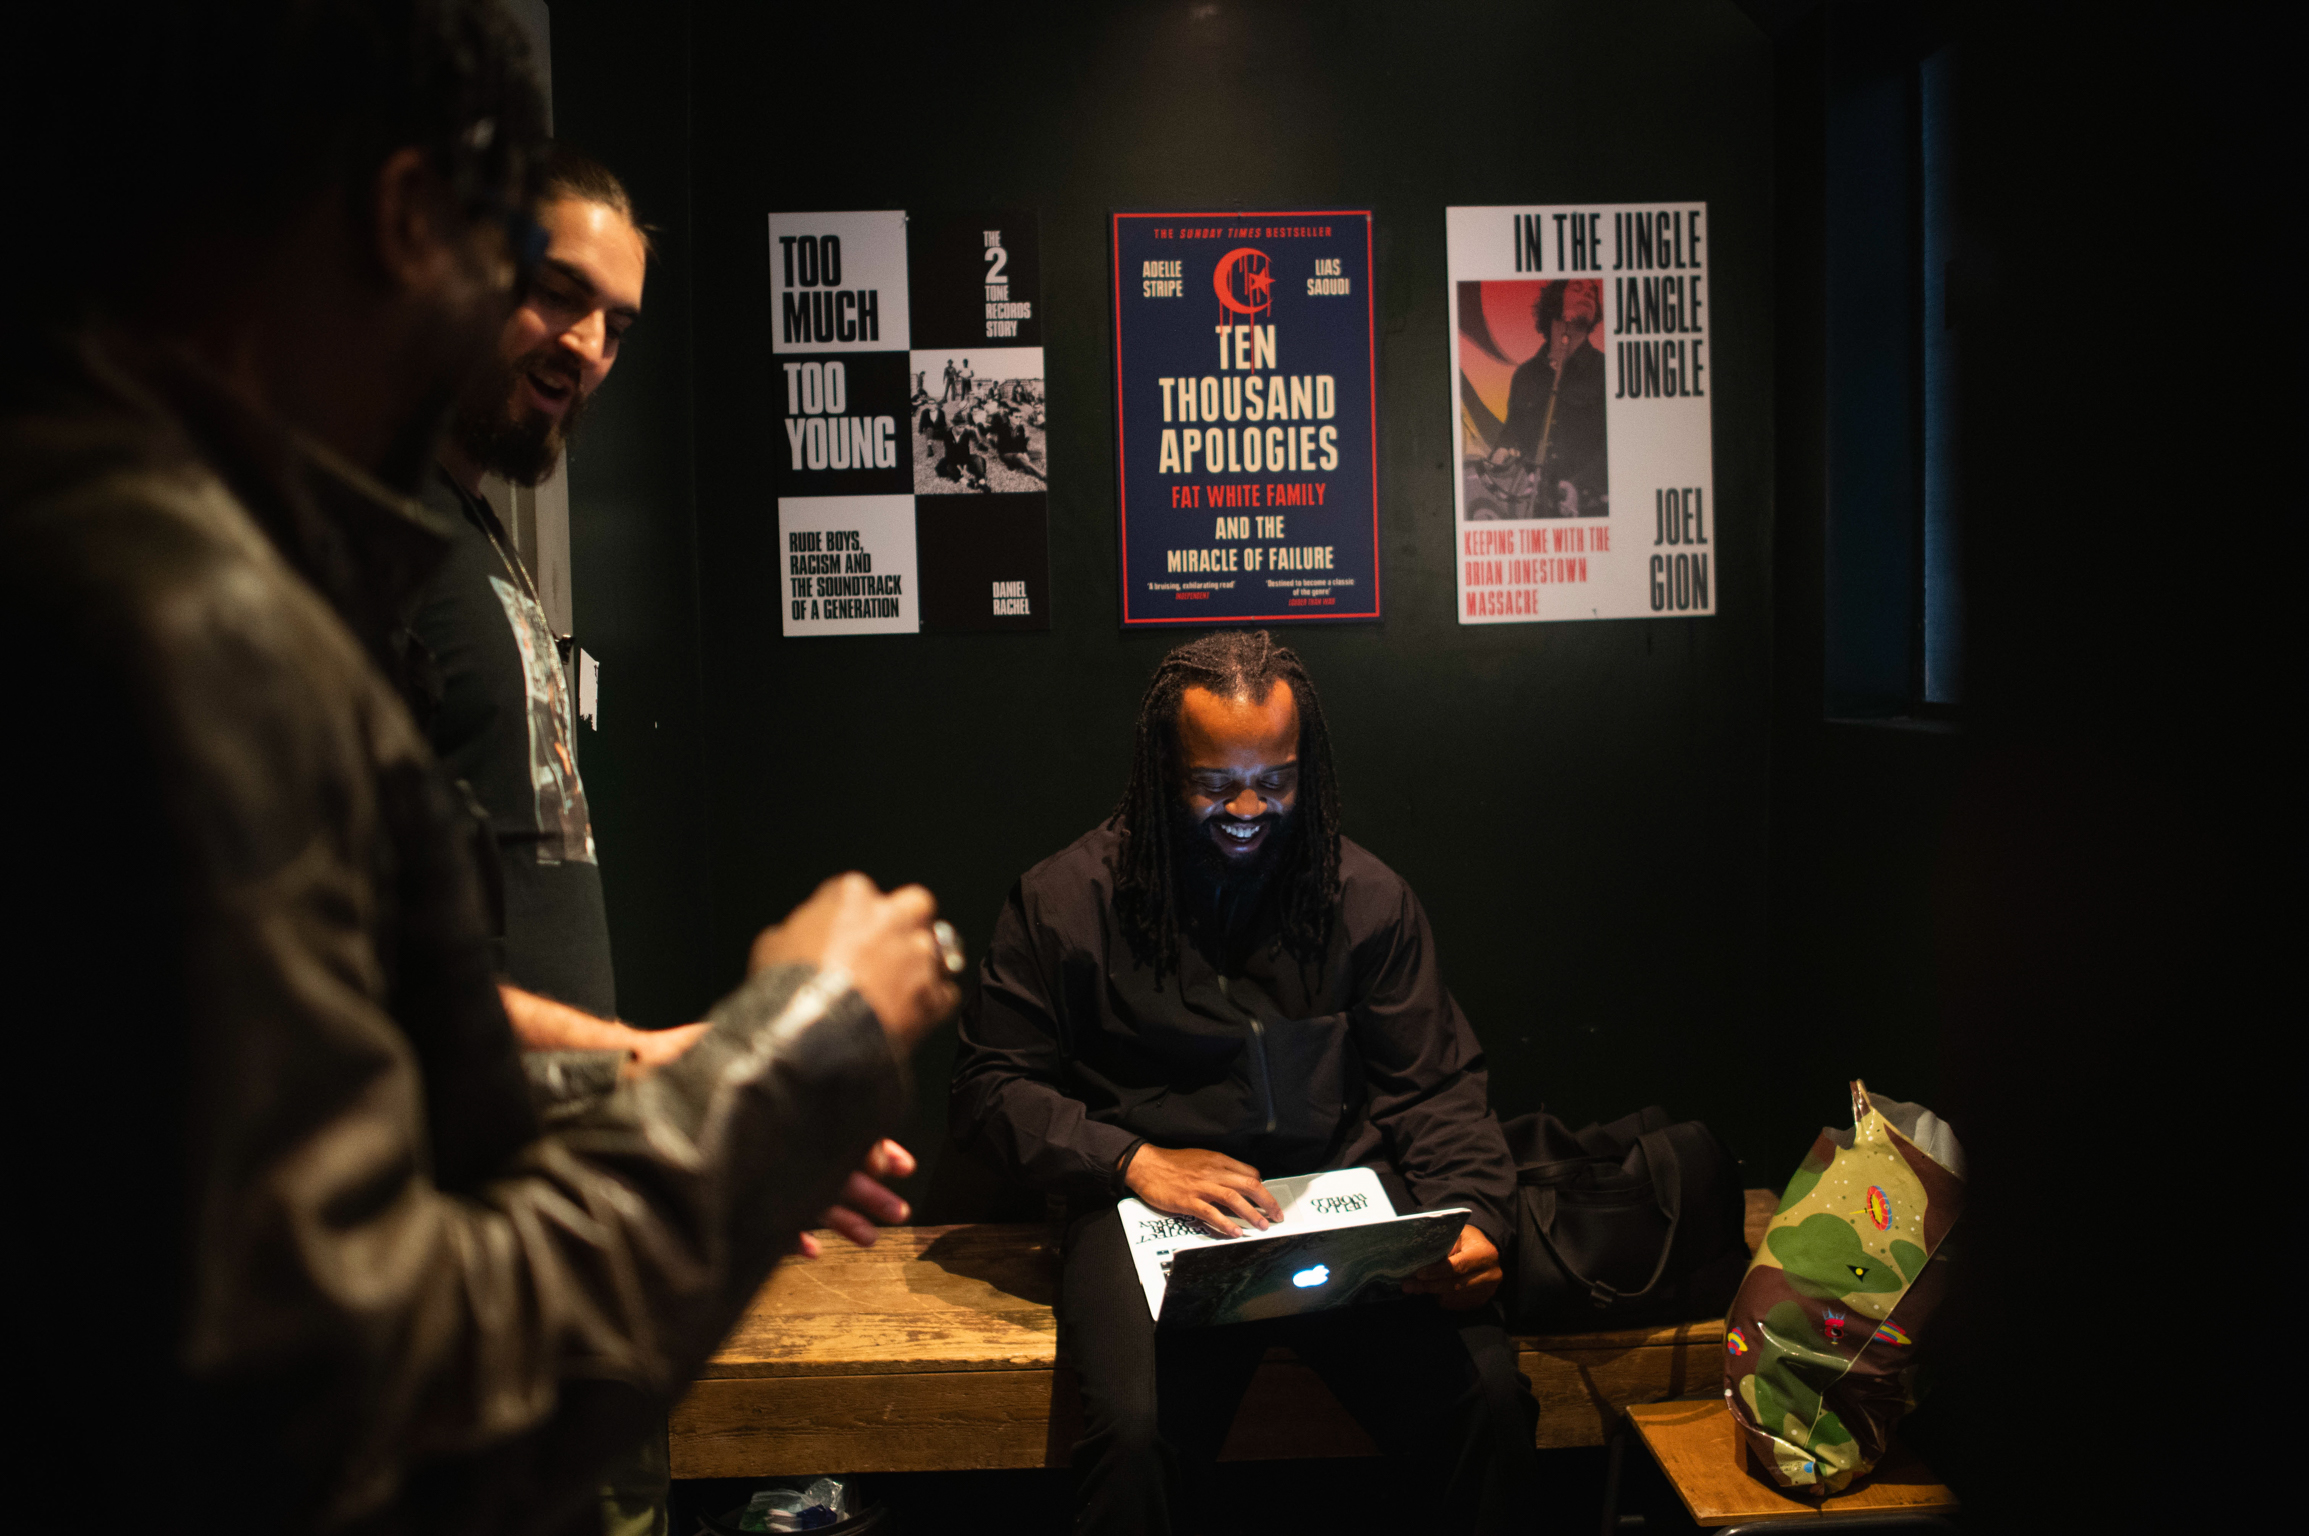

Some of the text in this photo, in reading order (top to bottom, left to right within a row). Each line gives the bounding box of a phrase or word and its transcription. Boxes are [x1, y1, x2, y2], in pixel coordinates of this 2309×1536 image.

[983, 230, 1000, 248] THE
[1154, 226, 1332, 239] THE SUNDAY TIMES BESTSELLER
[1514, 210, 1702, 272] IN THE JINGLE
[779, 235, 841, 288] TOO
[984, 247, 1008, 284] 2
[1142, 260, 1182, 278] ADELLE
[1315, 258, 1342, 276] LIAS
[985, 285, 1009, 302] TONE
[1143, 280, 1183, 298] STRIPE
[1306, 278, 1350, 296] SAOUDI
[782, 290, 879, 343] MUCH
[986, 302, 1031, 320] RECORDS
[1614, 274, 1702, 335] JANGLE
[986, 320, 1018, 337] STORY
[1215, 324, 1276, 370] TEN
[1615, 339, 1704, 399] JUNGLE
[783, 361, 846, 415] TOO
[1158, 374, 1336, 422] THOUSAND
[784, 416, 896, 470] YOUNG
[1158, 425, 1339, 474] APOLOGIES
[1172, 482, 1326, 508] FAT WHITE FAMILY
[1215, 516, 1285, 540] AND THE
[1654, 488, 1708, 546] JOEL
[789, 530, 864, 553] RUDE BOYS,
[1464, 526, 1610, 556] KEEPING TIME WITH THE
[790, 553, 872, 575] RACISM AND
[1167, 546, 1334, 572] MIRACLE OF FAILURE
[1332, 578, 1354, 586] classic
[1464, 557, 1587, 586] BRIAN JONESTOWN
[1650, 552, 1708, 612] GION
[790, 574, 902, 598] THE SOUNDTRACK
[992, 581, 1026, 598] DANIEL
[1176, 592, 1210, 600] INDEPENDENT
[1182, 582, 1218, 590] exhilarating
[792, 597, 899, 620] OF A GENERATION
[993, 598, 1030, 615] RACHEL
[1466, 589, 1538, 617] MASSACRE
